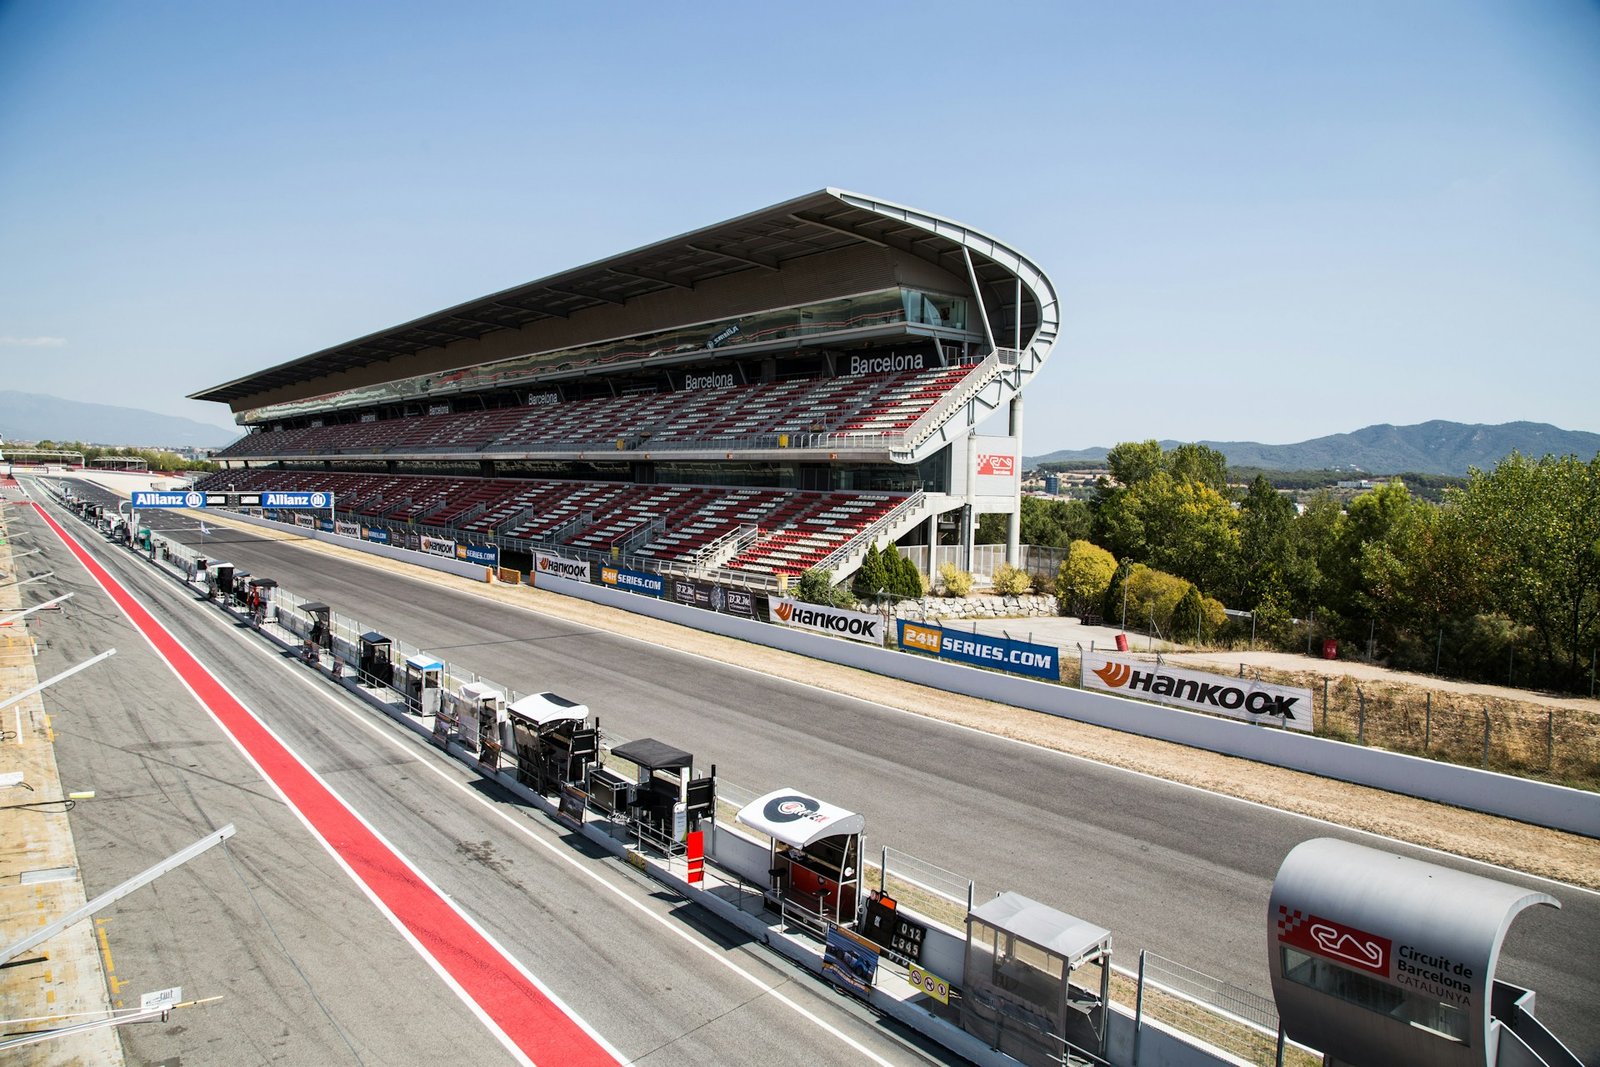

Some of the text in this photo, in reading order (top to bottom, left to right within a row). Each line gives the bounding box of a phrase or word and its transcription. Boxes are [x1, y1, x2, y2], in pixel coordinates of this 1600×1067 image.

[850, 352, 923, 375] Barcelona
[685, 371, 734, 390] Barcelona
[529, 391, 558, 405] Barcelona
[136, 493, 183, 505] Allianz
[267, 493, 308, 505] Allianz
[602, 570, 661, 590] 24H SERIES.COM
[905, 629, 1051, 669] 24H SERIES.COM
[1399, 945, 1472, 978] Circuit de
[1398, 959, 1472, 994] Barcelona
[1398, 975, 1470, 1006] CATALUNYA
